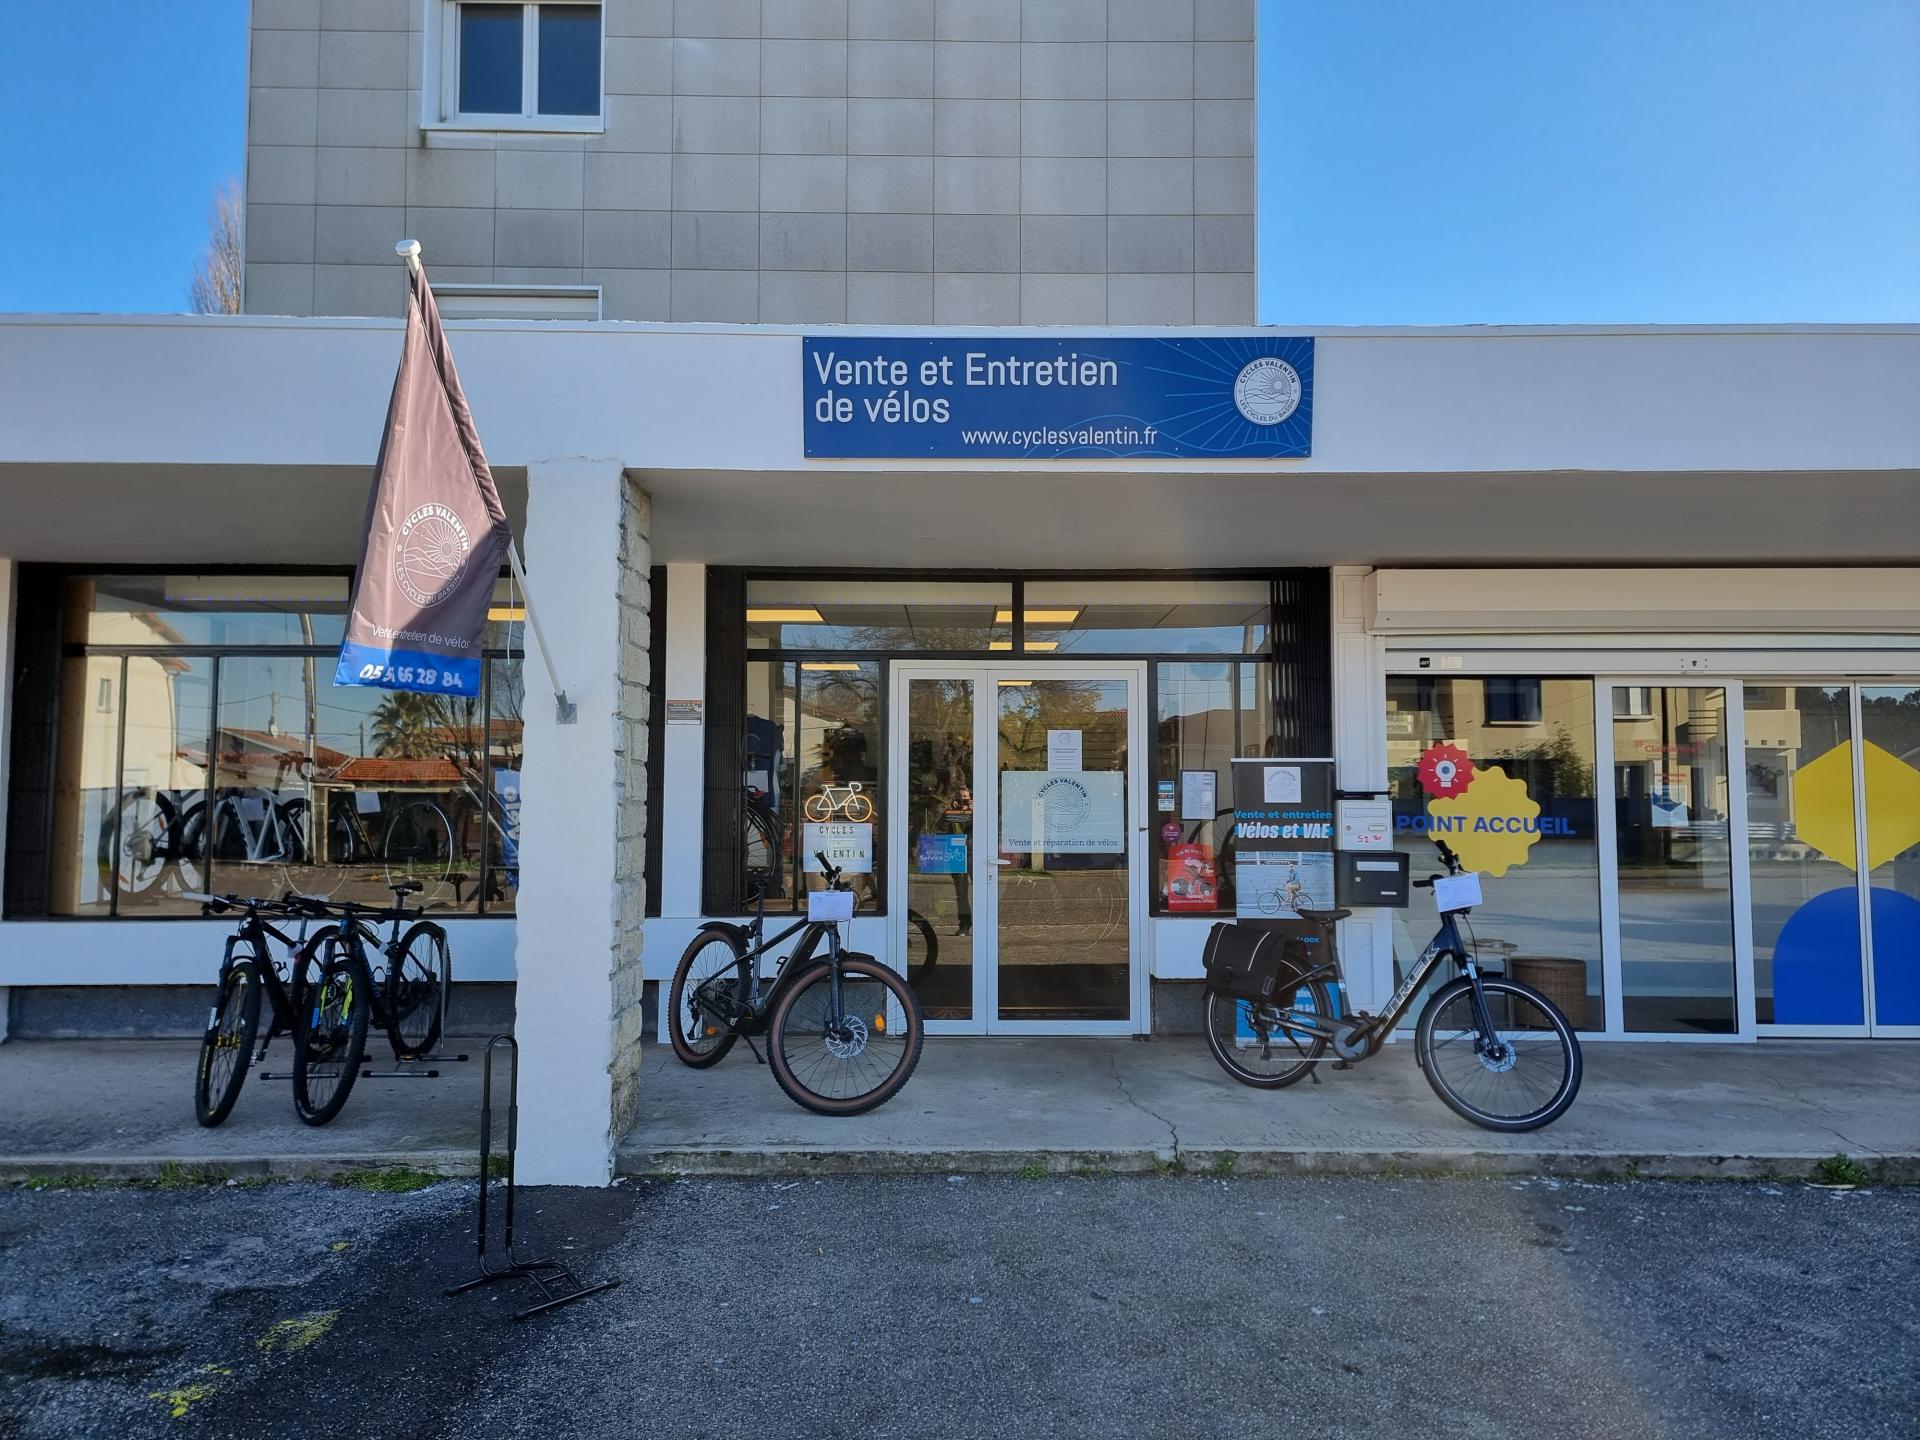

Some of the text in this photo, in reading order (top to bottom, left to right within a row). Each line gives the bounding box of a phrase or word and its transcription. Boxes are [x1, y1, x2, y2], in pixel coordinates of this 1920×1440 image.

[813, 352, 1118, 386] Vente et Entretien
[1240, 360, 1296, 384] CYCLES VALENTIN
[815, 389, 950, 423] de vélos
[1246, 409, 1268, 422] CYCLES
[1268, 414, 1278, 422] DU
[1278, 398, 1296, 419] BASSIN
[962, 426, 1157, 449] www.cyclesvalentin.fr
[402, 505, 469, 551] CYCLES VALENTIN
[396, 561, 406, 581] LES
[402, 580, 426, 604] CYCLES
[437, 575, 461, 601] BASSIN
[428, 632, 442, 644] de
[444, 634, 471, 649] vélos
[359, 663, 384, 680] 05
[416, 667, 438, 685] 28
[441, 671, 463, 689] 84
[1038, 778, 1087, 798] CYCLES VALENTIN
[1235, 810, 1333, 819] Vente et entretien
[1395, 815, 1577, 835] POINT ACCUEIL
[819, 825, 855, 835] CYCLES
[1237, 821, 1331, 839] Vélos et VAE
[814, 849, 865, 859] VLENTIN
[1008, 838, 1118, 849] Vente et réparation de vélos
[919, 854, 944, 862] Service
[1384, 940, 1441, 1020] TREK
